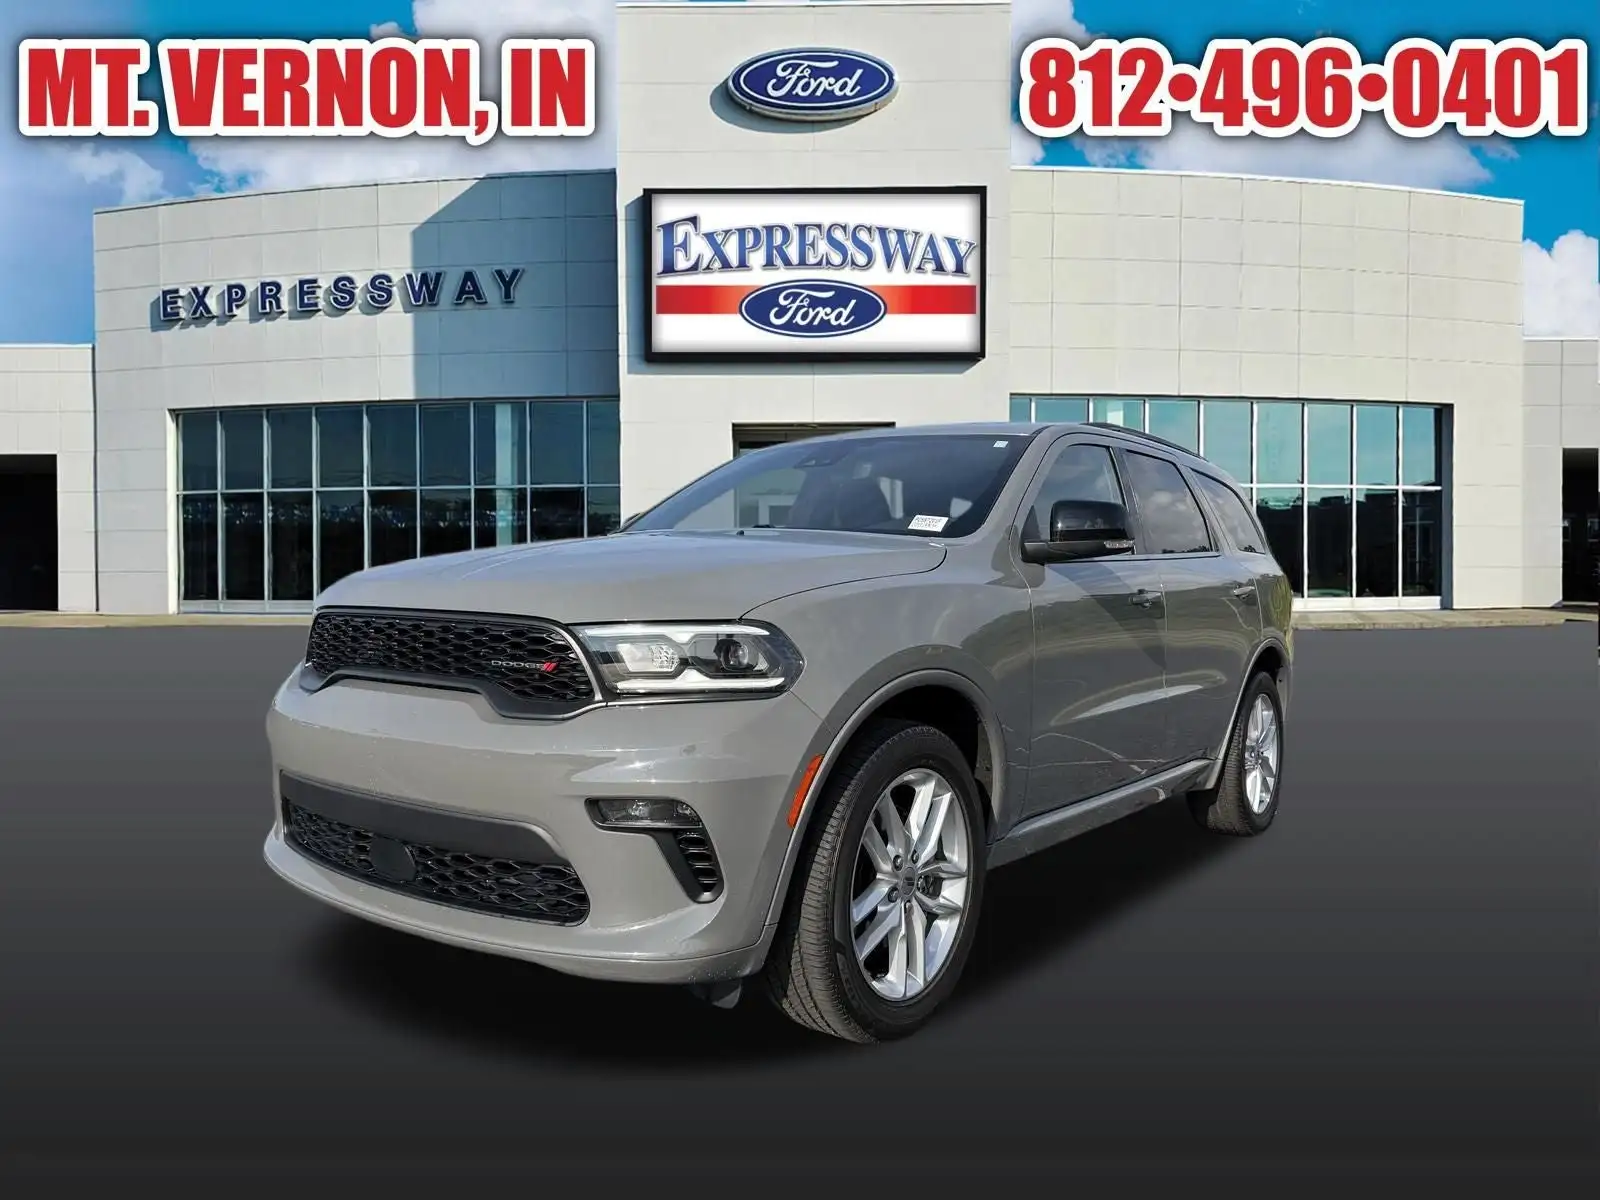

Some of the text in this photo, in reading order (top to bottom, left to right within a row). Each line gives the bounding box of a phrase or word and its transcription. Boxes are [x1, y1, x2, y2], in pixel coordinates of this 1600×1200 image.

[766, 59, 864, 97] Ford
[655, 213, 977, 278] EXPRESSWAY
[160, 268, 523, 321] EXPRESSWAY
[769, 288, 857, 326] Ford
[491, 660, 545, 670] DODGE
